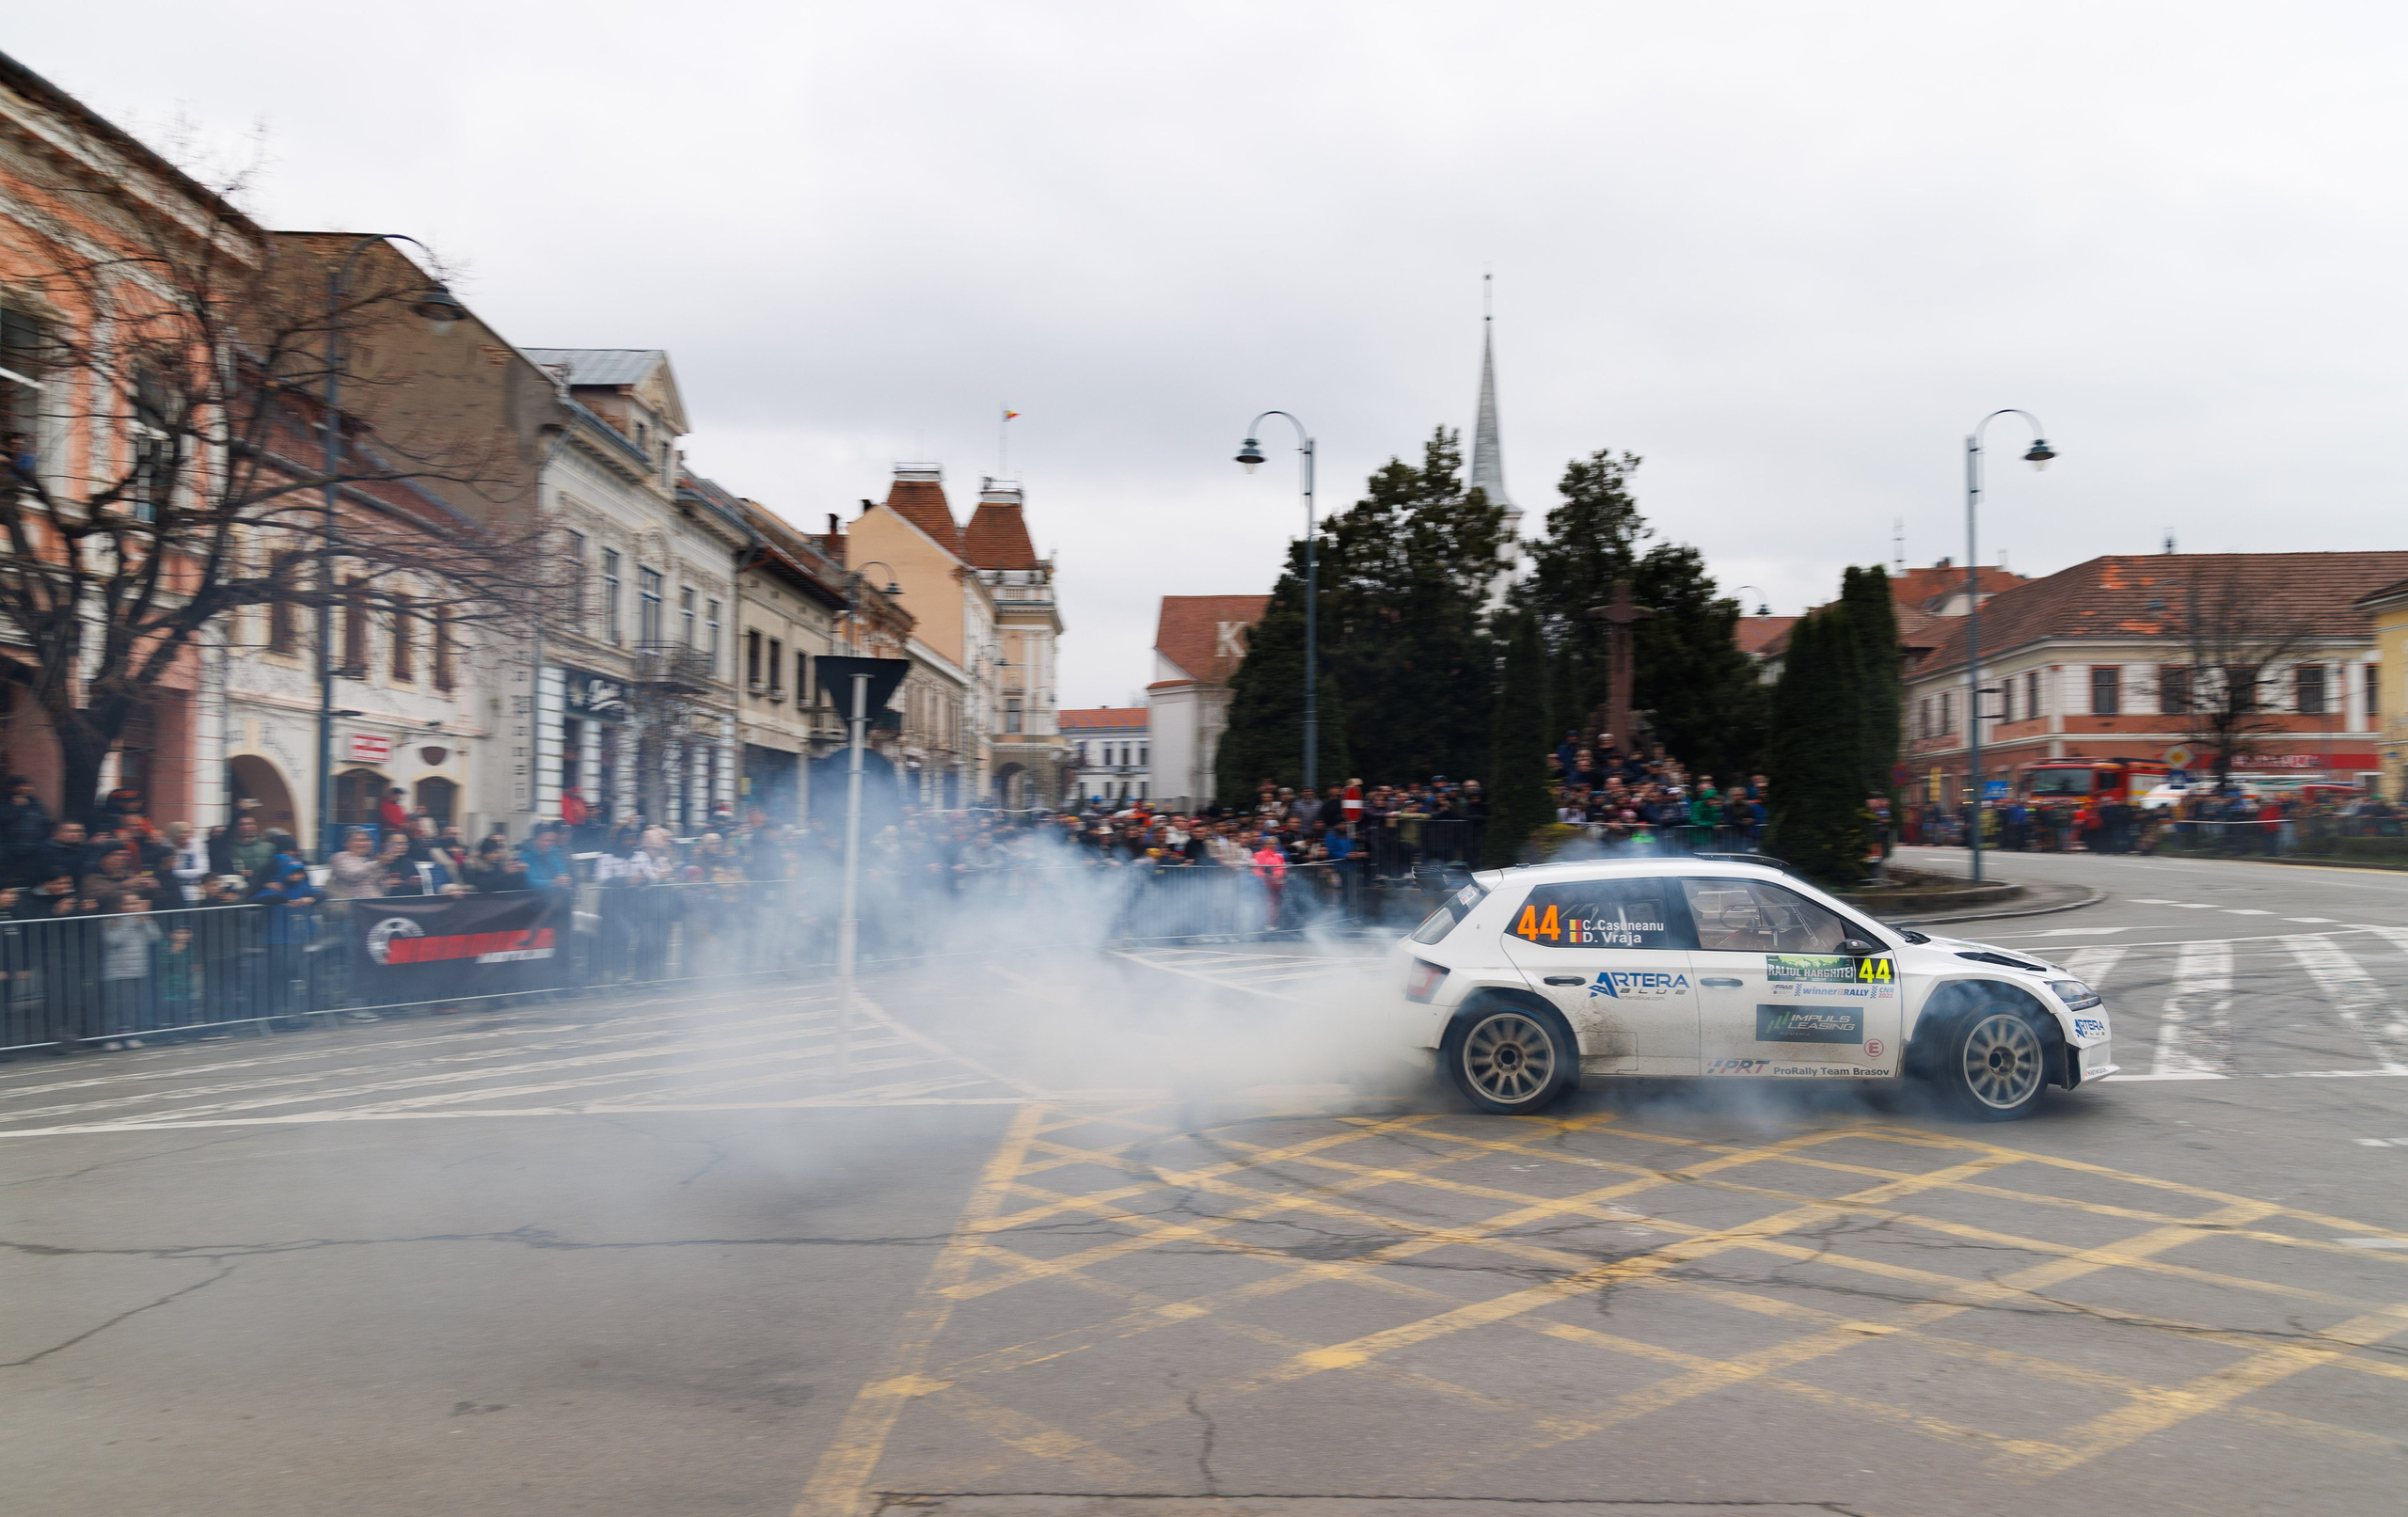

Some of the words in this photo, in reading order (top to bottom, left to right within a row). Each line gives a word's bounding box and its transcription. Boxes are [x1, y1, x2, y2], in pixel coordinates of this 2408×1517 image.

[1517, 905, 1561, 941] 44
[1582, 919, 1594, 931] C.
[1597, 919, 1665, 932] Casuneanu
[1582, 931, 1598, 943] D.
[1602, 931, 1642, 946] Vraja
[1768, 963, 1801, 977] RALIUL
[1859, 957, 1892, 984] 44
[1588, 972, 1690, 999] ARTERA
[1802, 987, 1838, 996] winner
[1843, 988, 1870, 997] RALLY
[1791, 1014, 1850, 1023] IMPULS
[1787, 1021, 1855, 1031] LEASING
[2075, 1019, 2105, 1038] ARTERA
[1868, 1042, 1879, 1053] E
[1774, 1067, 1817, 1076] ProRally
[1820, 1067, 1849, 1076] Team
[1853, 1067, 1890, 1076] Brasov
